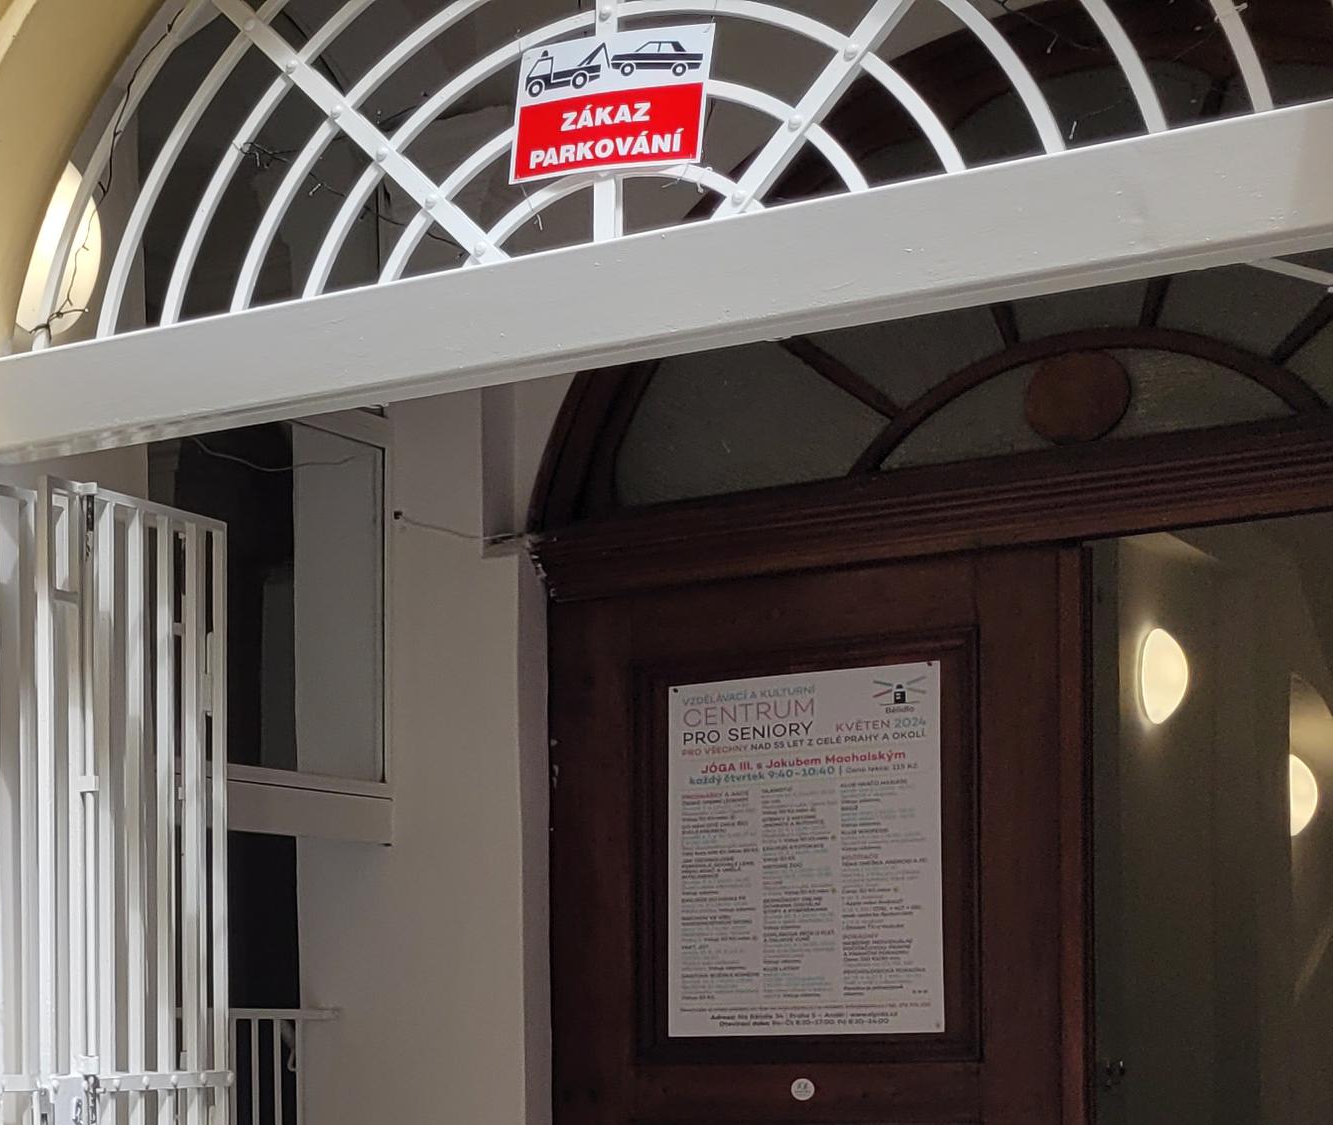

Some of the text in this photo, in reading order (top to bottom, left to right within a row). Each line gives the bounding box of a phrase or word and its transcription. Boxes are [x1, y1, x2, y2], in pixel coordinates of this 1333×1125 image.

[560, 101, 651, 132] ZÁKAZ
[528, 128, 685, 170] PARKOVÁNÍ
[683, 684, 815, 706] VZDĚLÁVACÍ A KULTURNÍ
[683, 698, 814, 728] CENTRUM
[835, 716, 927, 733] KVĚTEN 2024
[683, 720, 813, 745] PRO SENIORY
[704, 744, 750, 755] VŠECHNY
[750, 742, 772, 751] NAD
[787, 739, 804, 748] LET
[806, 738, 814, 746] Z
[816, 735, 843, 746] CELÉ
[844, 733, 879, 743] PRAHY
[881, 733, 890, 741] A
[892, 728, 925, 740] OKOLÍ
[701, 761, 736, 774] JÓGA
[739, 761, 754, 771] III.
[765, 756, 822, 769] Jakubem
[689, 774, 722, 786] každý
[724, 771, 765, 783] čtvrtek
